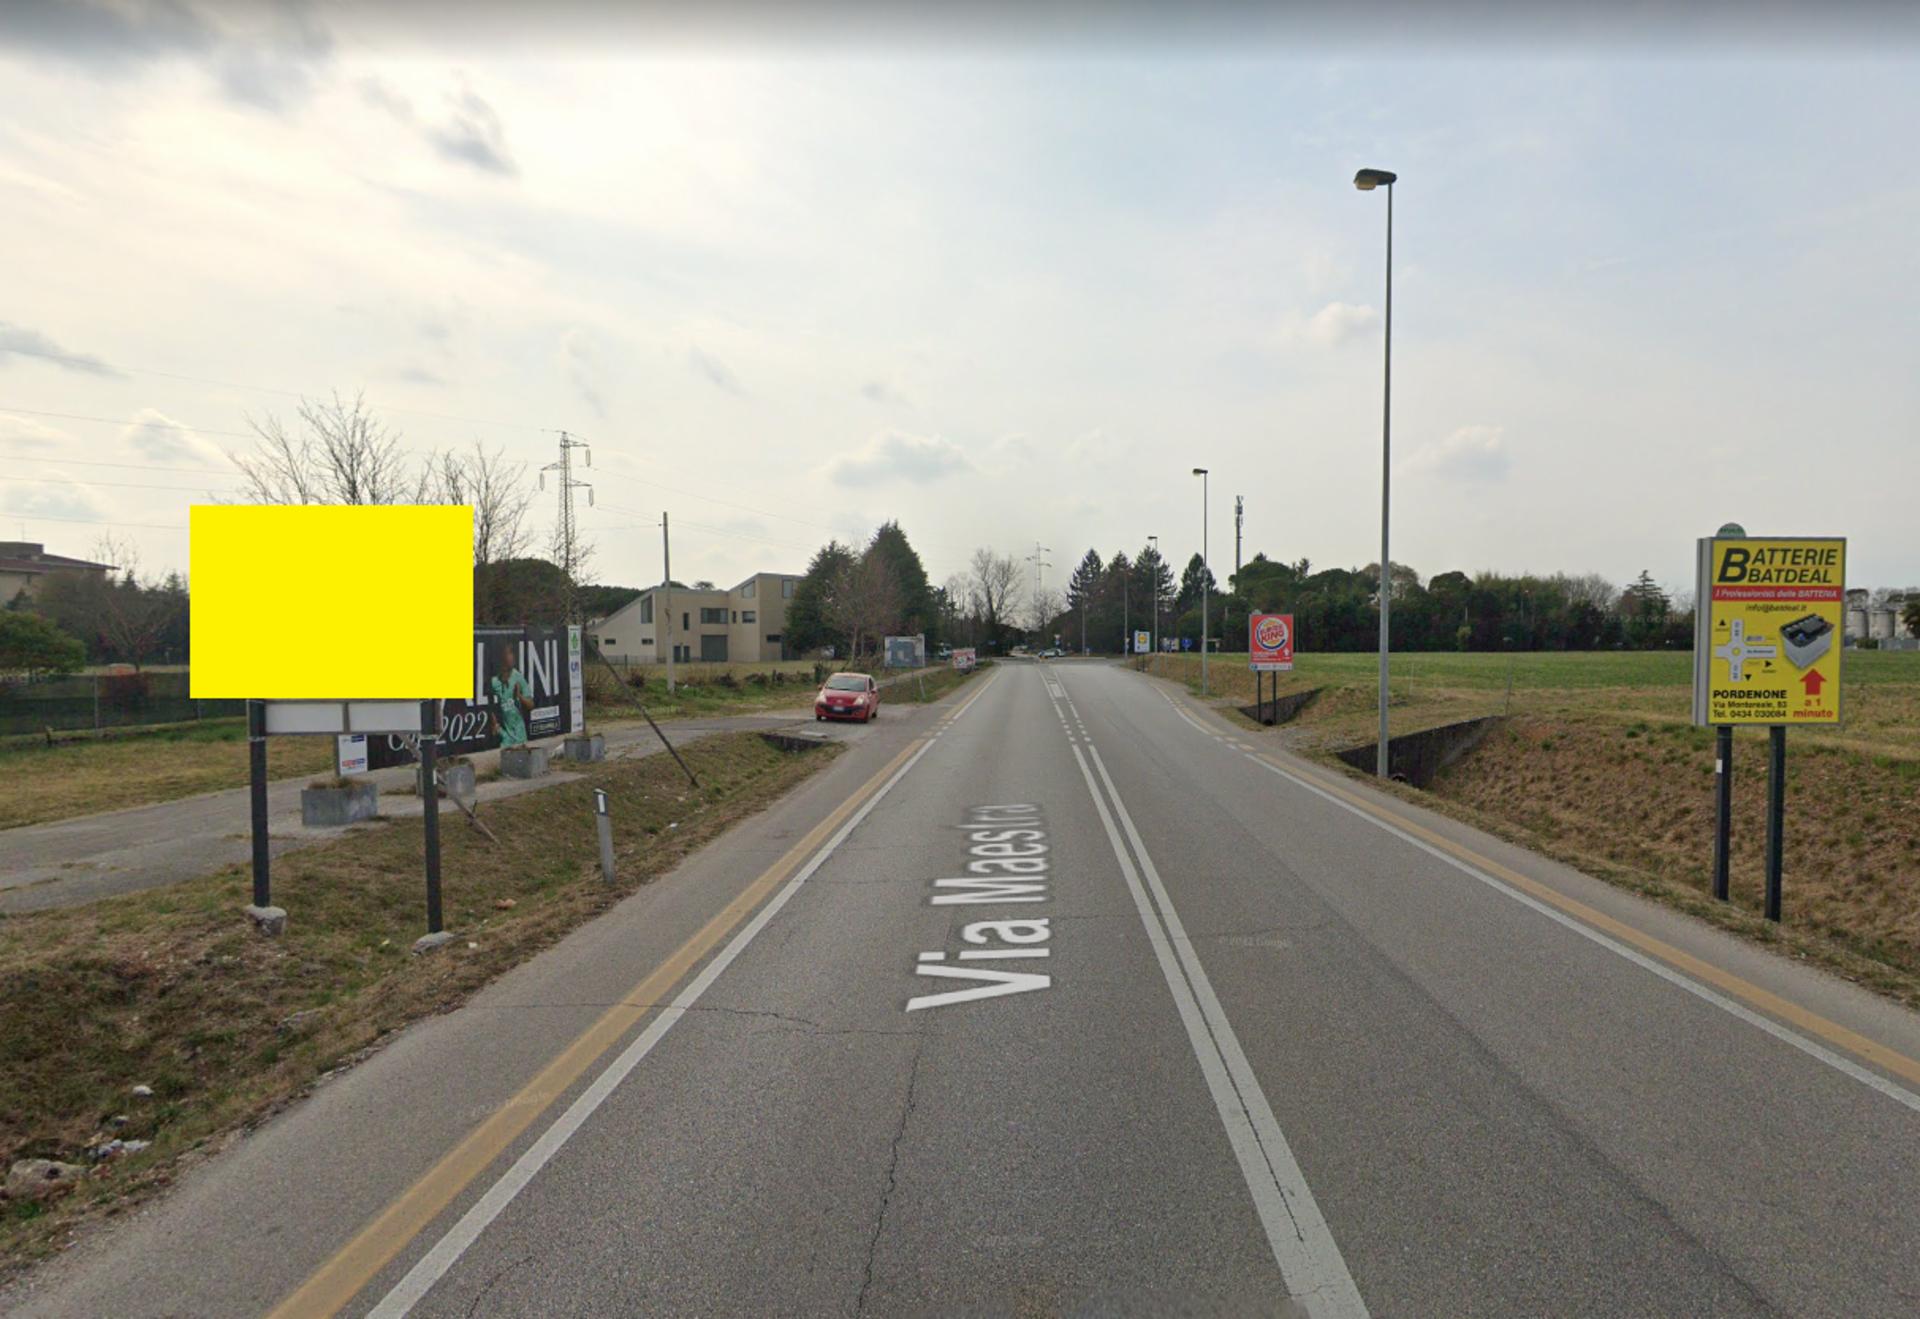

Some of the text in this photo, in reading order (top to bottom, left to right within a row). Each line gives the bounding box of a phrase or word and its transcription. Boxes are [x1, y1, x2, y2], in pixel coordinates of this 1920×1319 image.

[1718, 547, 1838, 583] BATTERIE
[1747, 567, 1833, 583] BATDEAL
[1713, 689, 1788, 699] PORDENONE
[1713, 700, 1725, 708] Via
[1792, 708, 1834, 718] minuto
[435, 710, 488, 745] 2022
